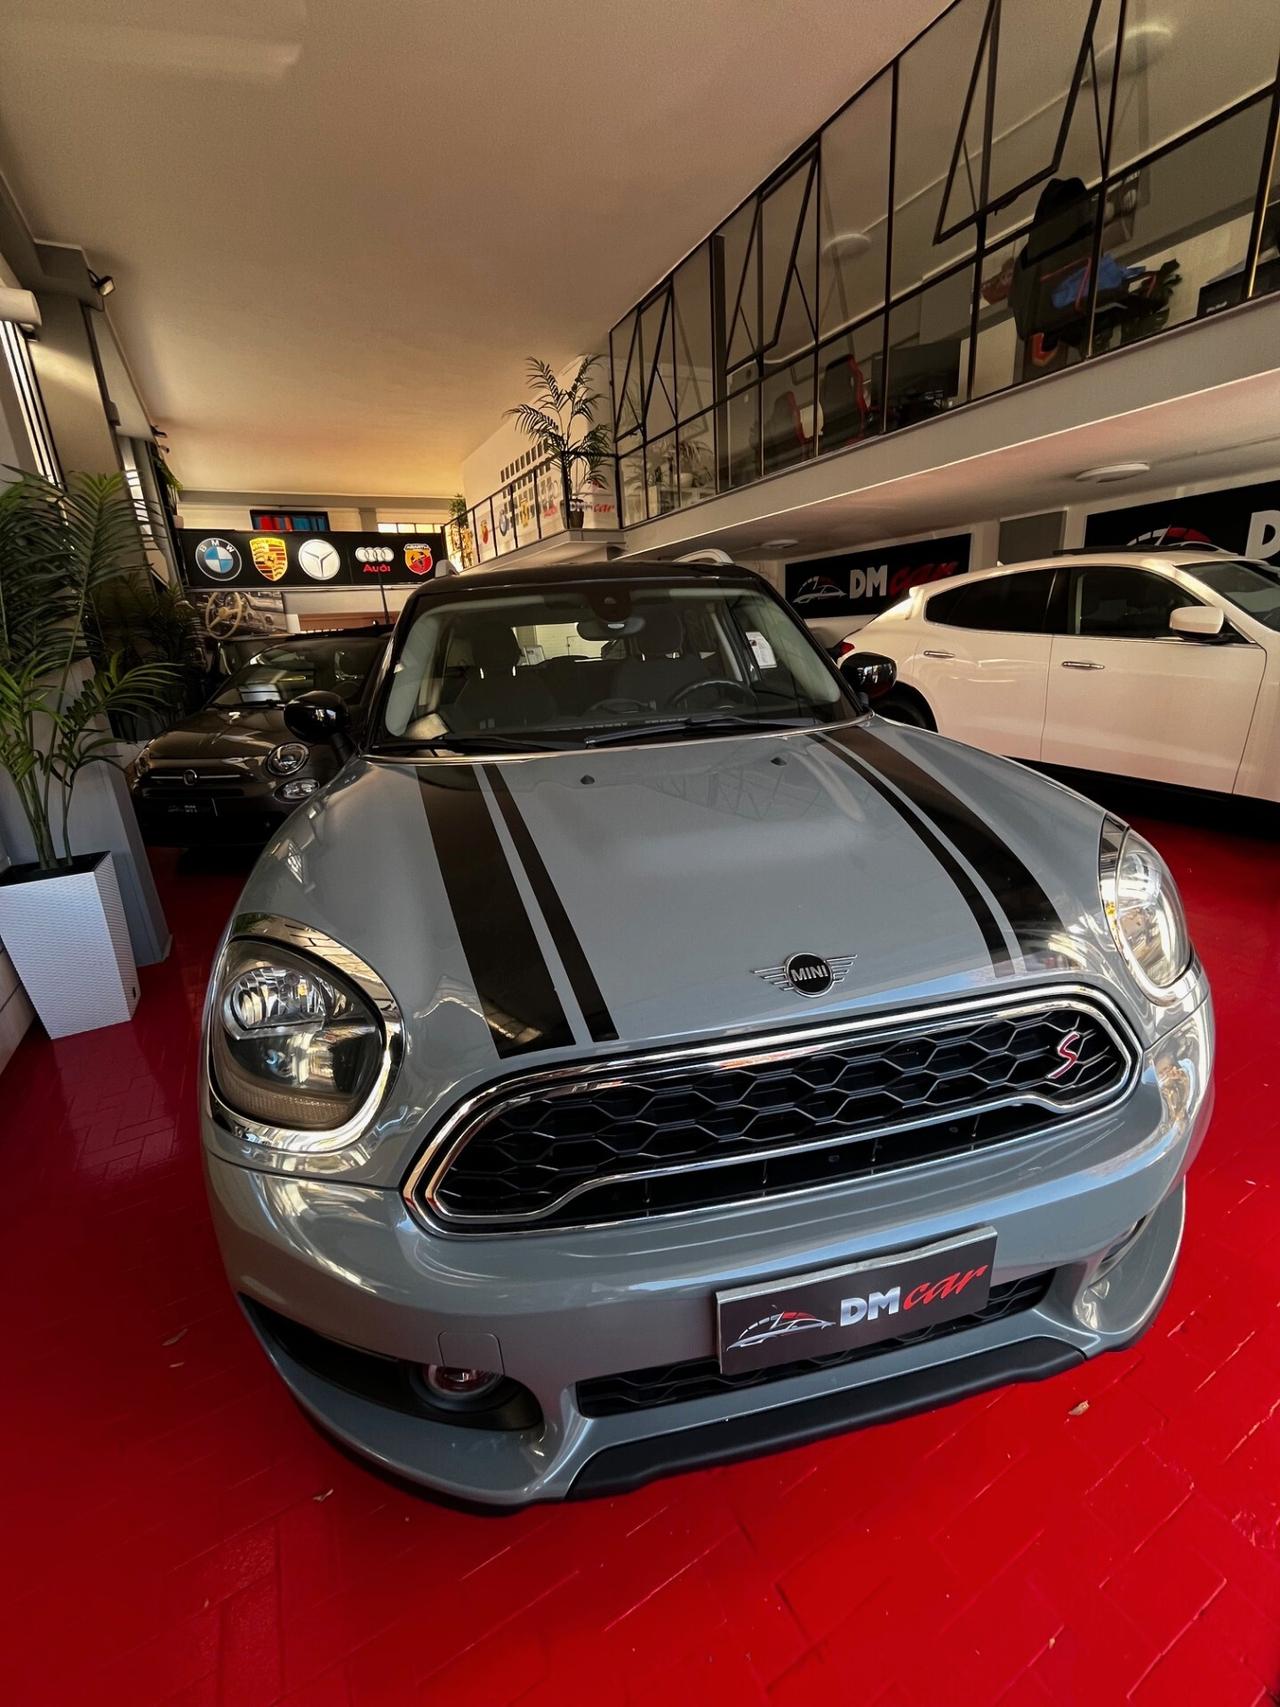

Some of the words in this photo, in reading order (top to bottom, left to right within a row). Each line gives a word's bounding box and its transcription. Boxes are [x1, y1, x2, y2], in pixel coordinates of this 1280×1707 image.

[199, 539, 235, 553] BMW
[362, 563, 391, 573] Audi
[849, 564, 888, 600] DM
[790, 964, 829, 982] MINI
[1045, 1031, 1080, 1079] S
[839, 1286, 901, 1327] DM
[903, 1264, 989, 1310] car
